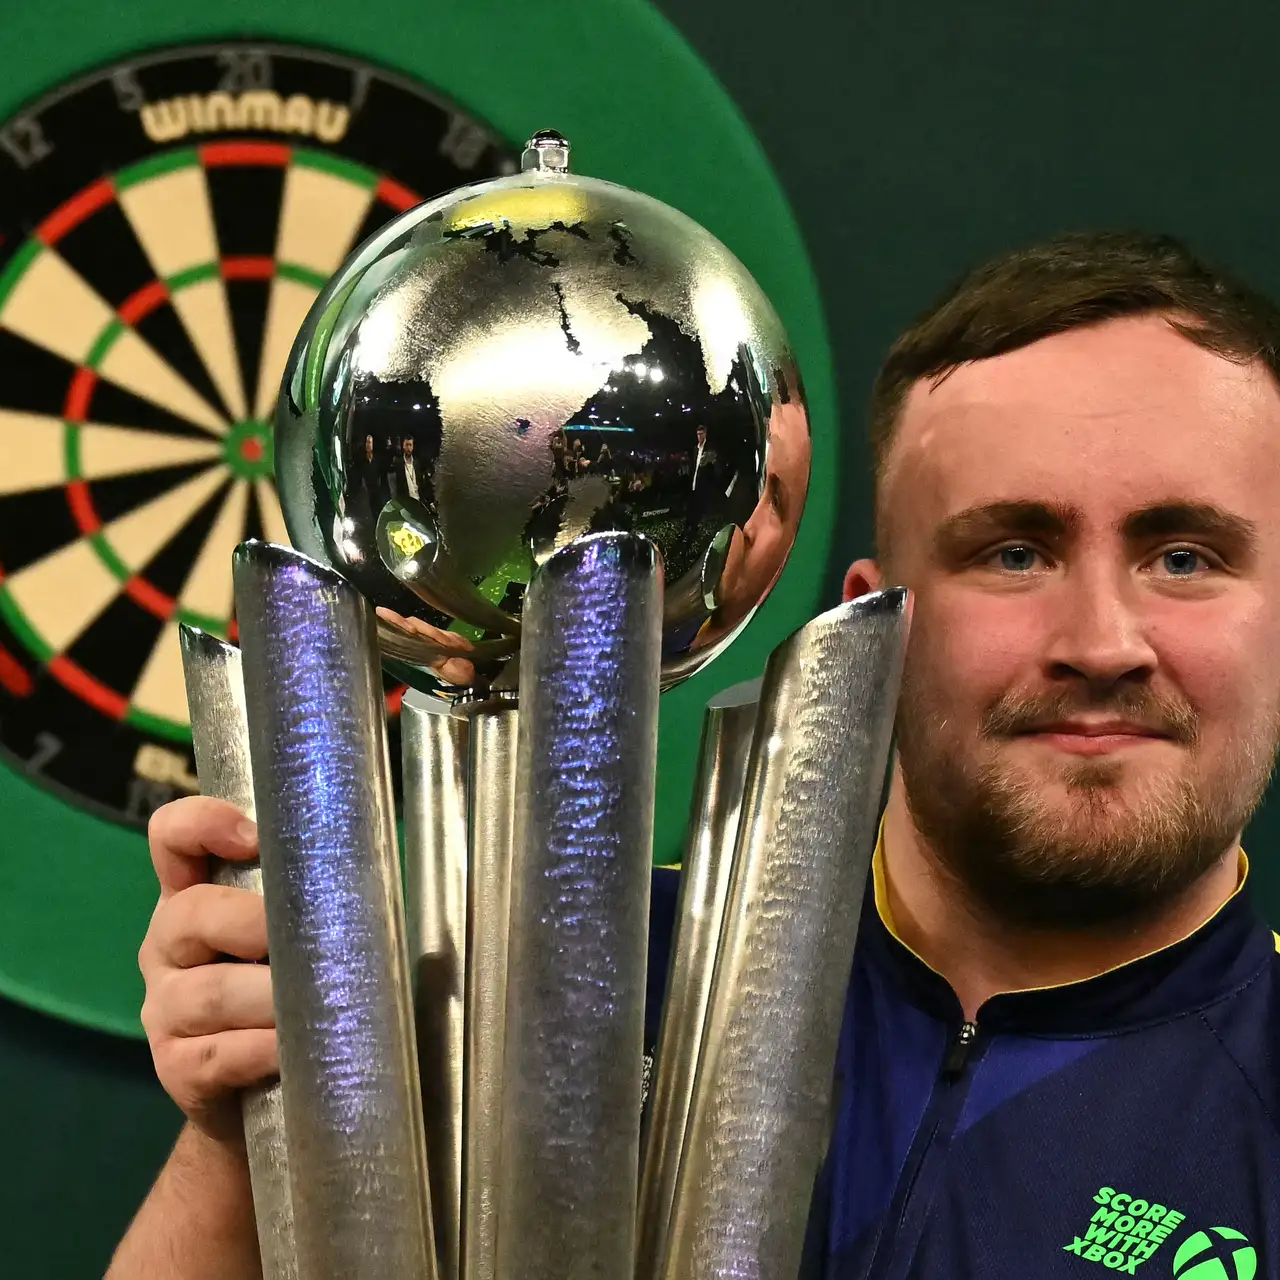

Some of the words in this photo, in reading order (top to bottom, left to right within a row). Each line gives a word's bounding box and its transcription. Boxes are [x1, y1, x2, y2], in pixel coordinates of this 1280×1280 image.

[113, 70, 144, 111] 5
[221, 53, 271, 92] 20
[1, 118, 54, 167] 12
[24, 731, 64, 774] 7
[1090, 1206, 1173, 1244] MORE
[1092, 1186, 1186, 1230] SCORE
[1062, 1235, 1146, 1276] XBOX
[1084, 1222, 1160, 1260] WITH
